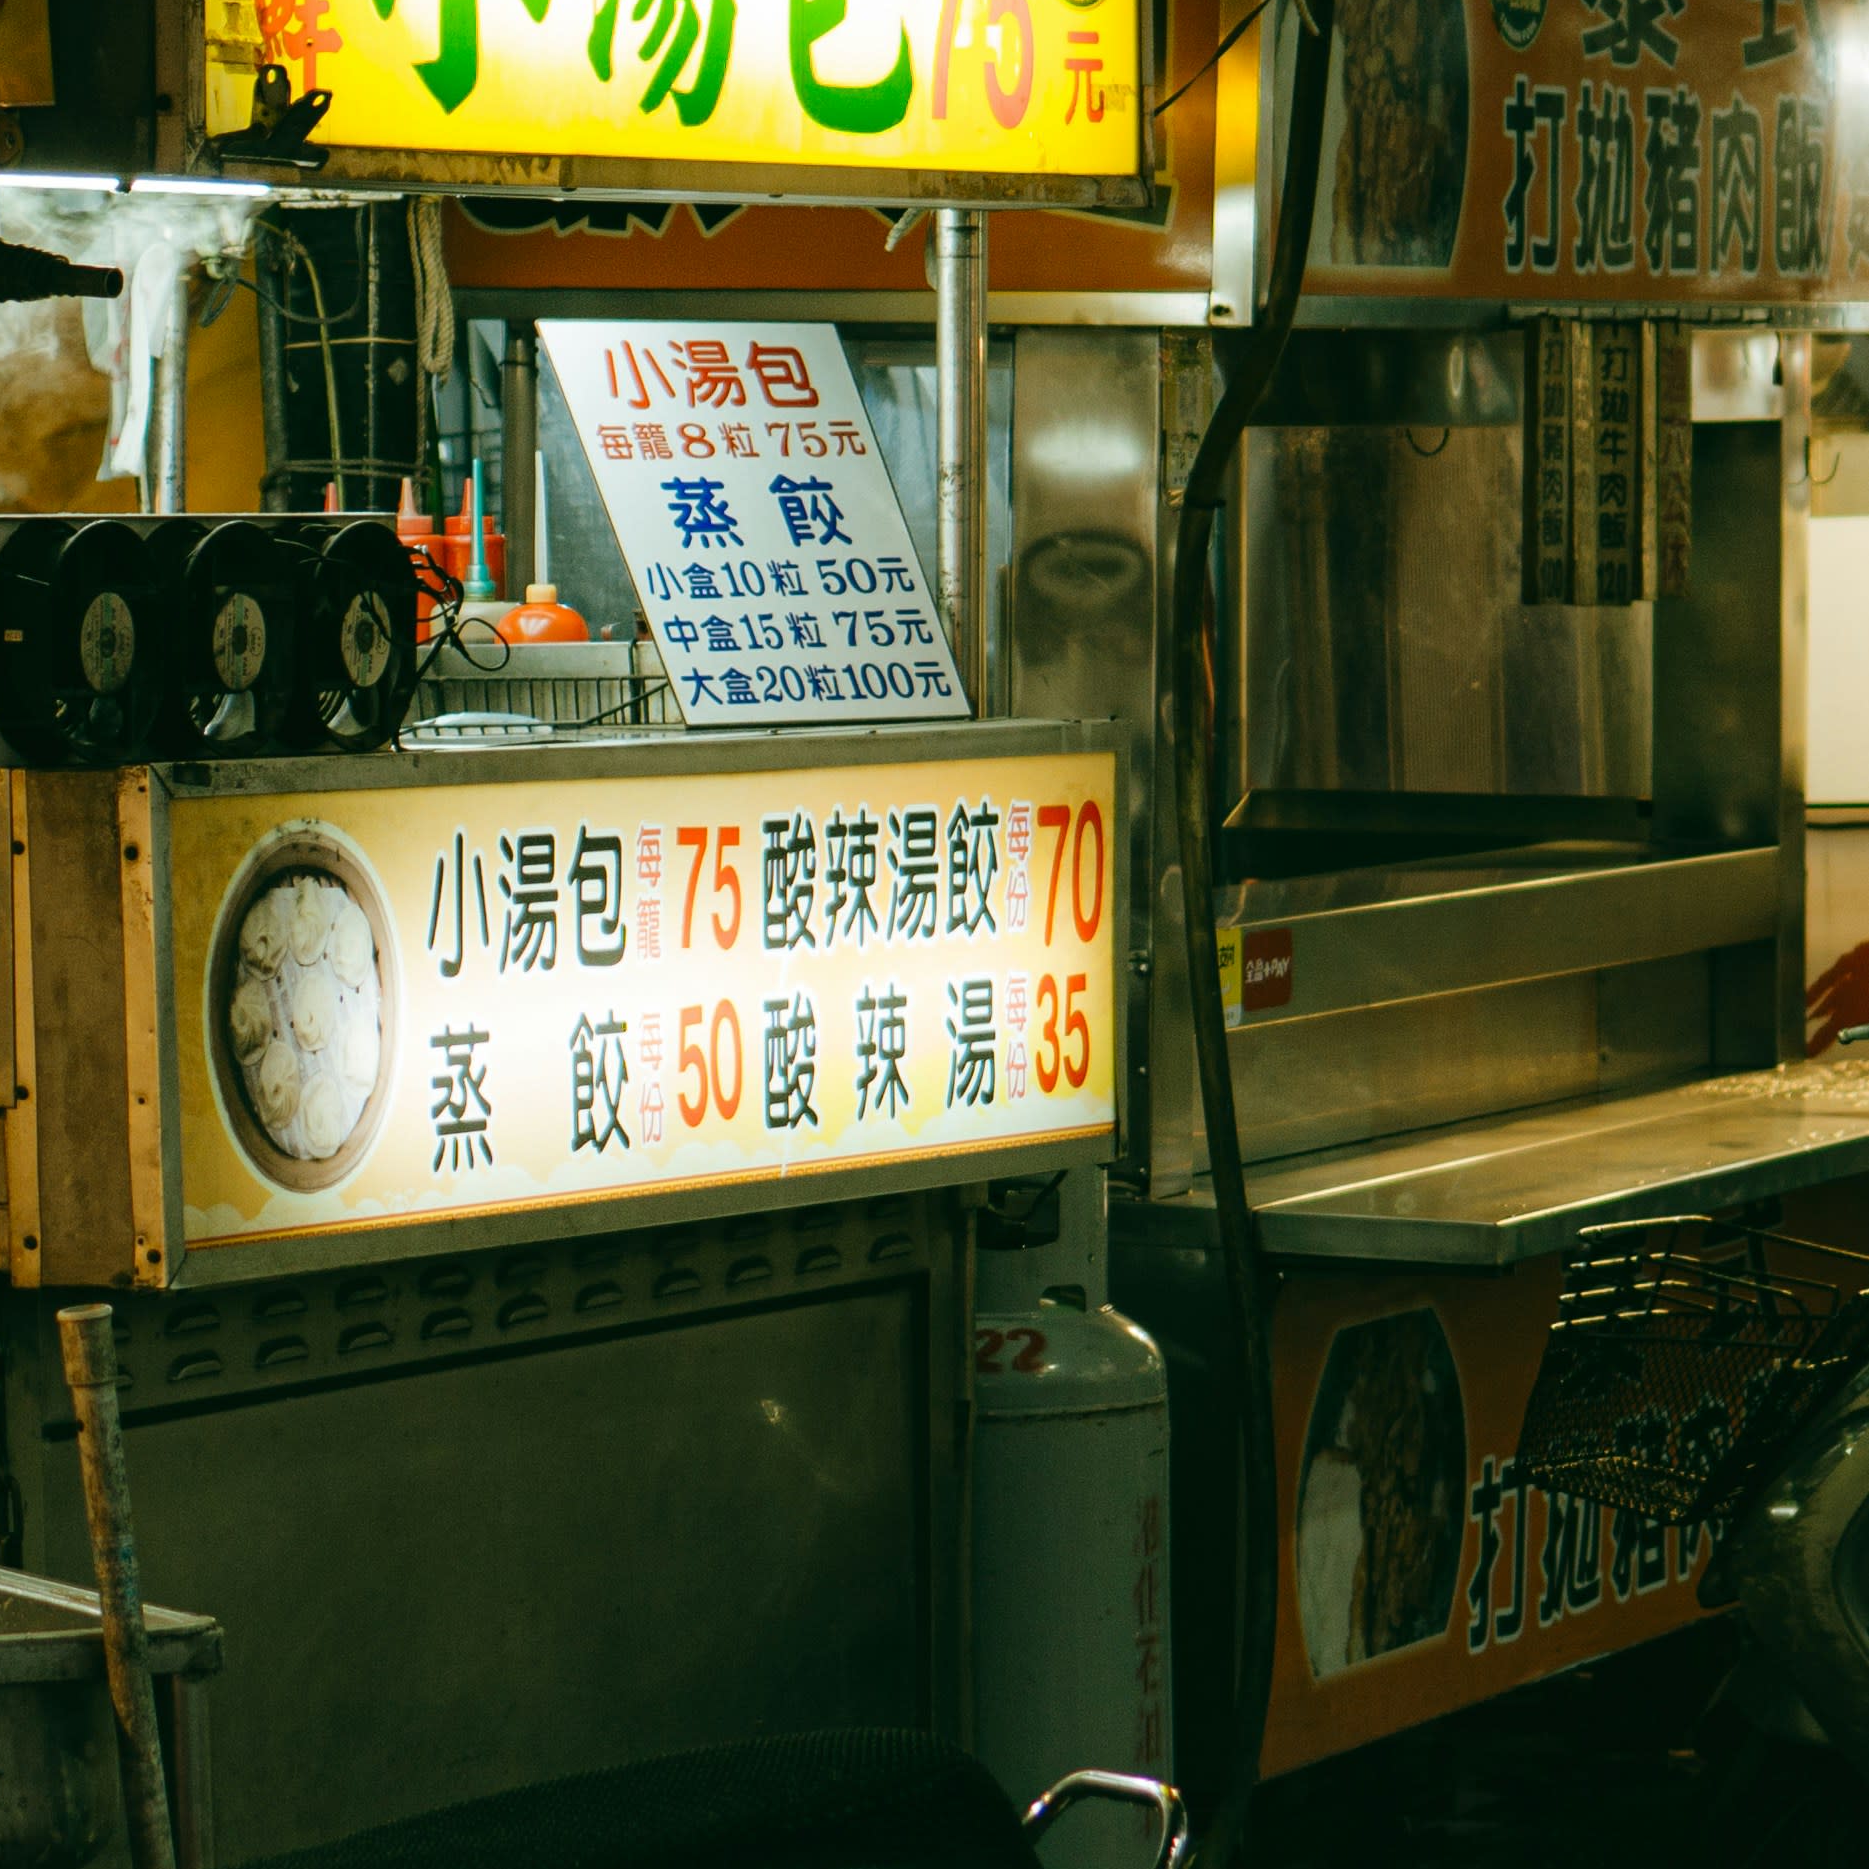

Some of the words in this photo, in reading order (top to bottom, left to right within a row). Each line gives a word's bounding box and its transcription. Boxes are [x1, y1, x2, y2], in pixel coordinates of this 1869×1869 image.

[603, 340, 820, 410] 小湯包
[660, 473, 853, 549] 蒸餃
[427, 822, 627, 978] 小湯包
[675, 825, 742, 951] 75
[761, 799, 999, 952] 酸辣湯餃
[1036, 799, 1104, 947] 70
[675, 997, 743, 1129] 50
[761, 979, 997, 1130] 酸辣湯
[1034, 972, 1090, 1094] 35
